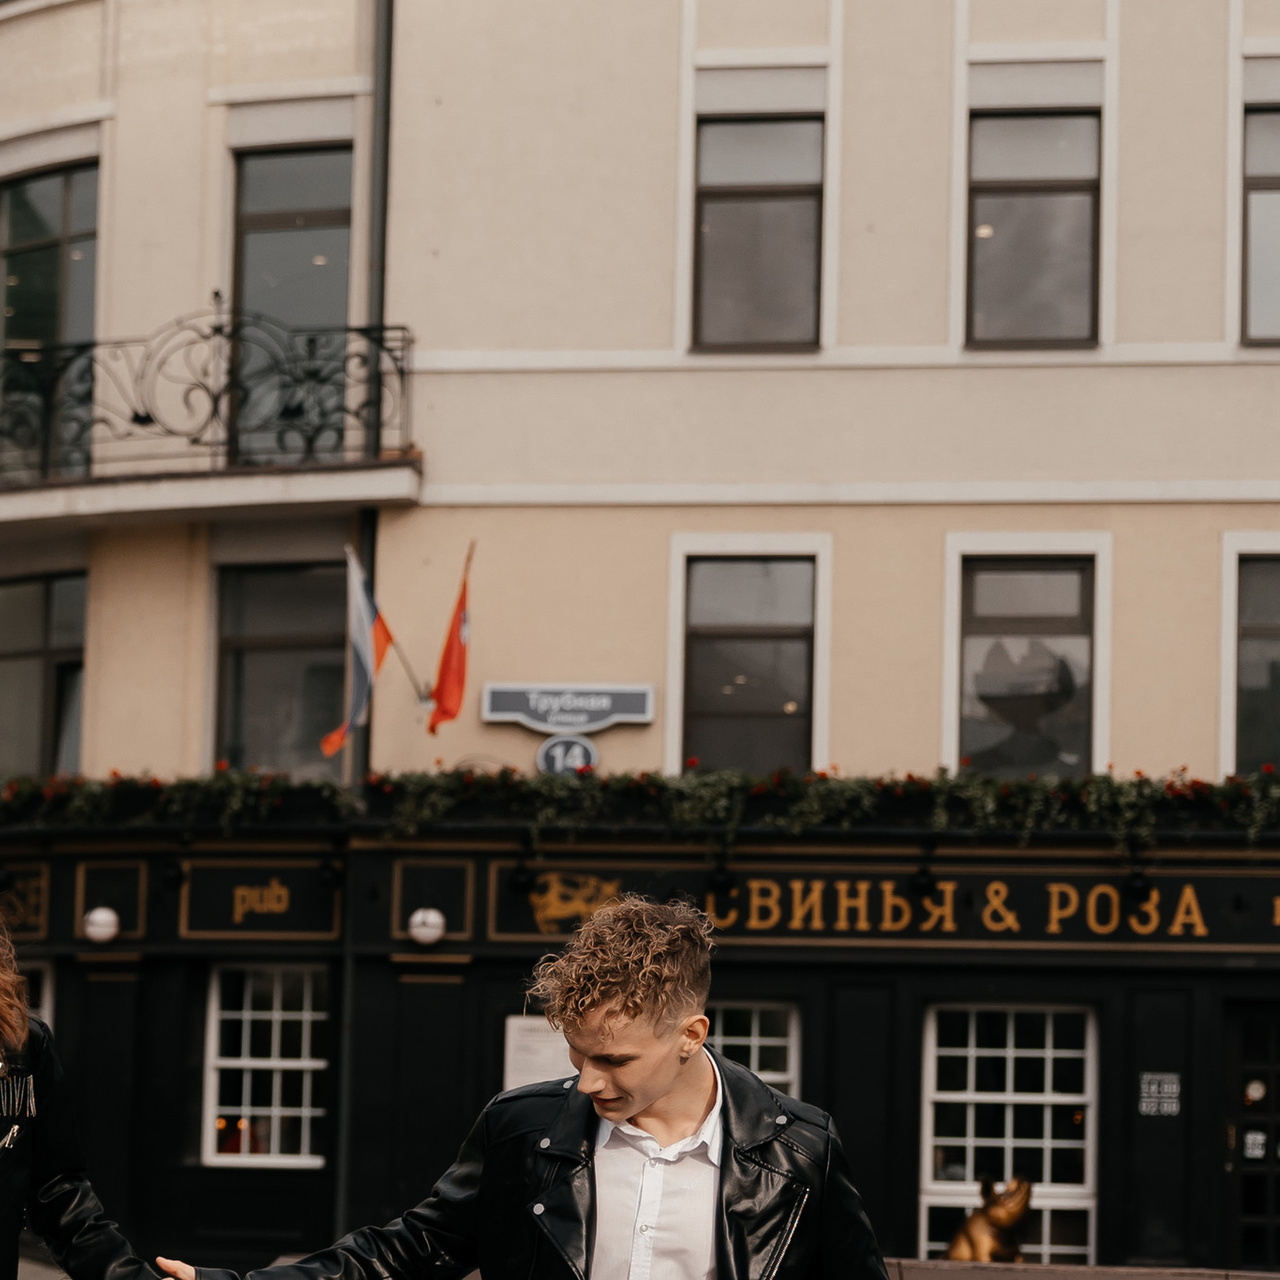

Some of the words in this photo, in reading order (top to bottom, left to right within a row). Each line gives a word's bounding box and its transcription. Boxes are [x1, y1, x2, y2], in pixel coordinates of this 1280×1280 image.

[549, 744, 584, 771] 14
[233, 877, 290, 924] pub
[981, 880, 1020, 932] &
[1046, 882, 1209, 937] РОЗА
